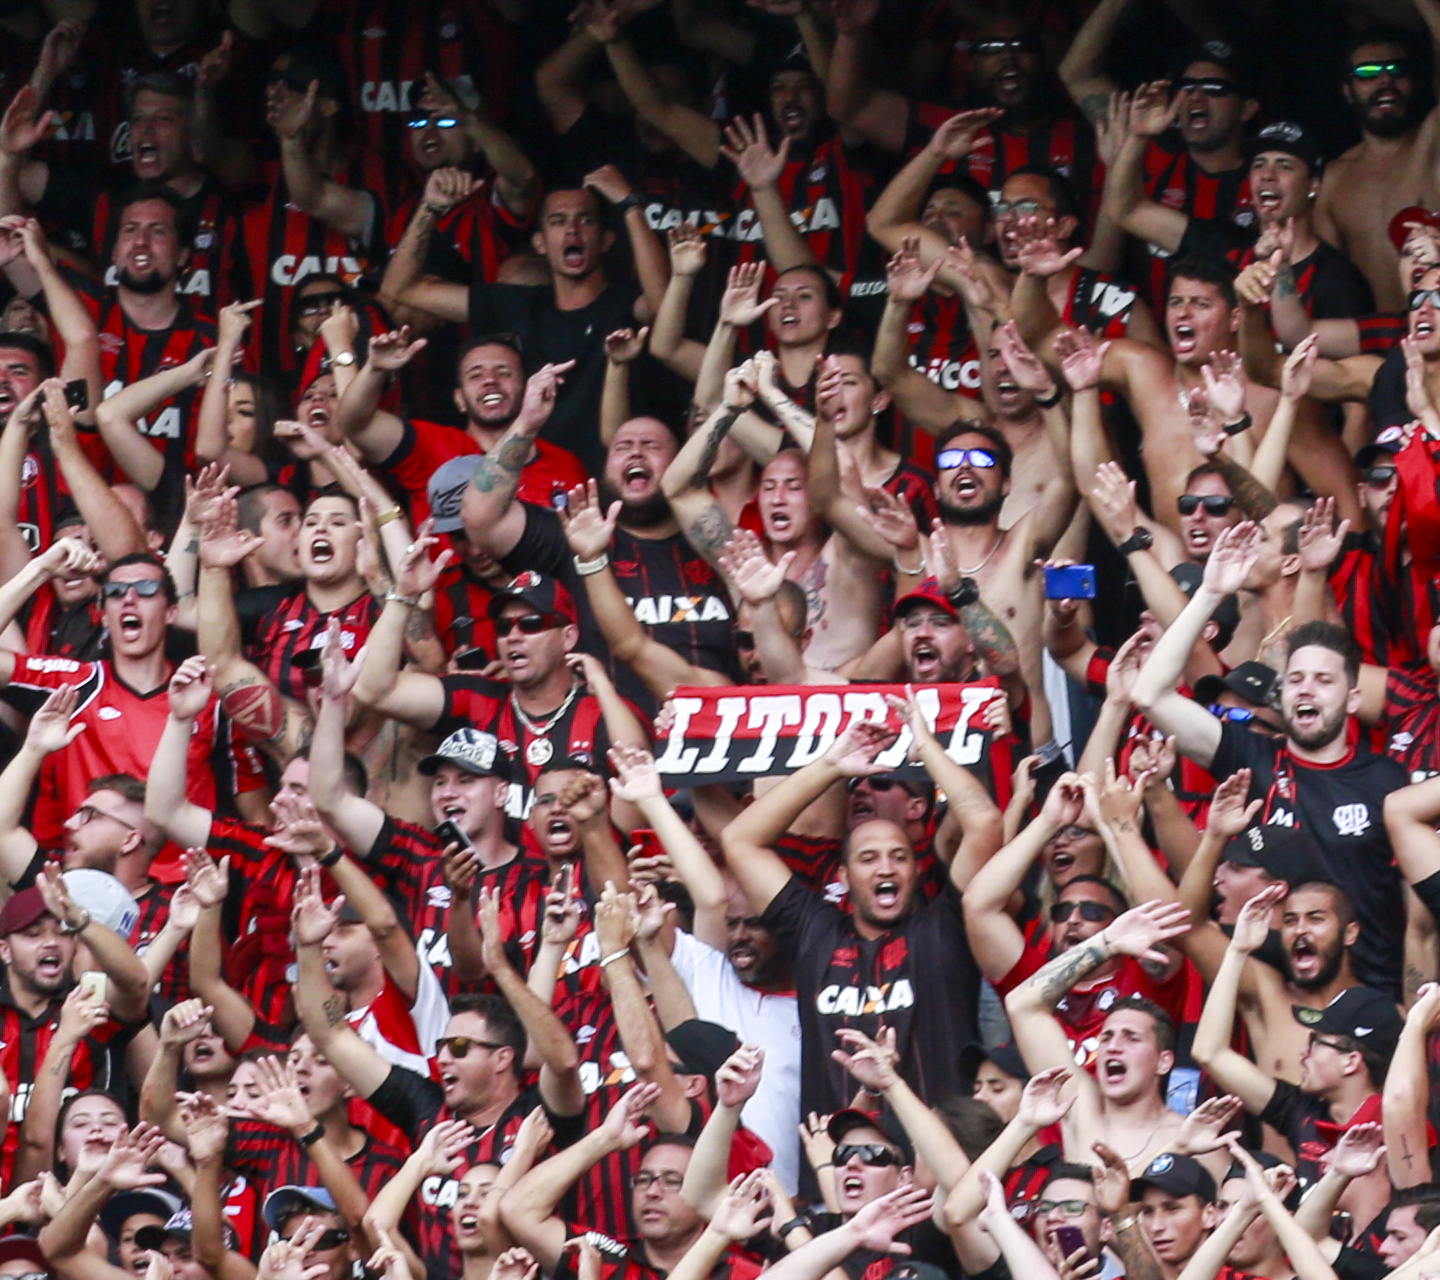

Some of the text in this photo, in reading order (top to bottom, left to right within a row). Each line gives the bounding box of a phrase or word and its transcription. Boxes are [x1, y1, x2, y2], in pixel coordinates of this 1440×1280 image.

[626, 597, 729, 623] AIXA
[659, 686, 995, 778] LITORL
[815, 979, 914, 1017] CAIXA
